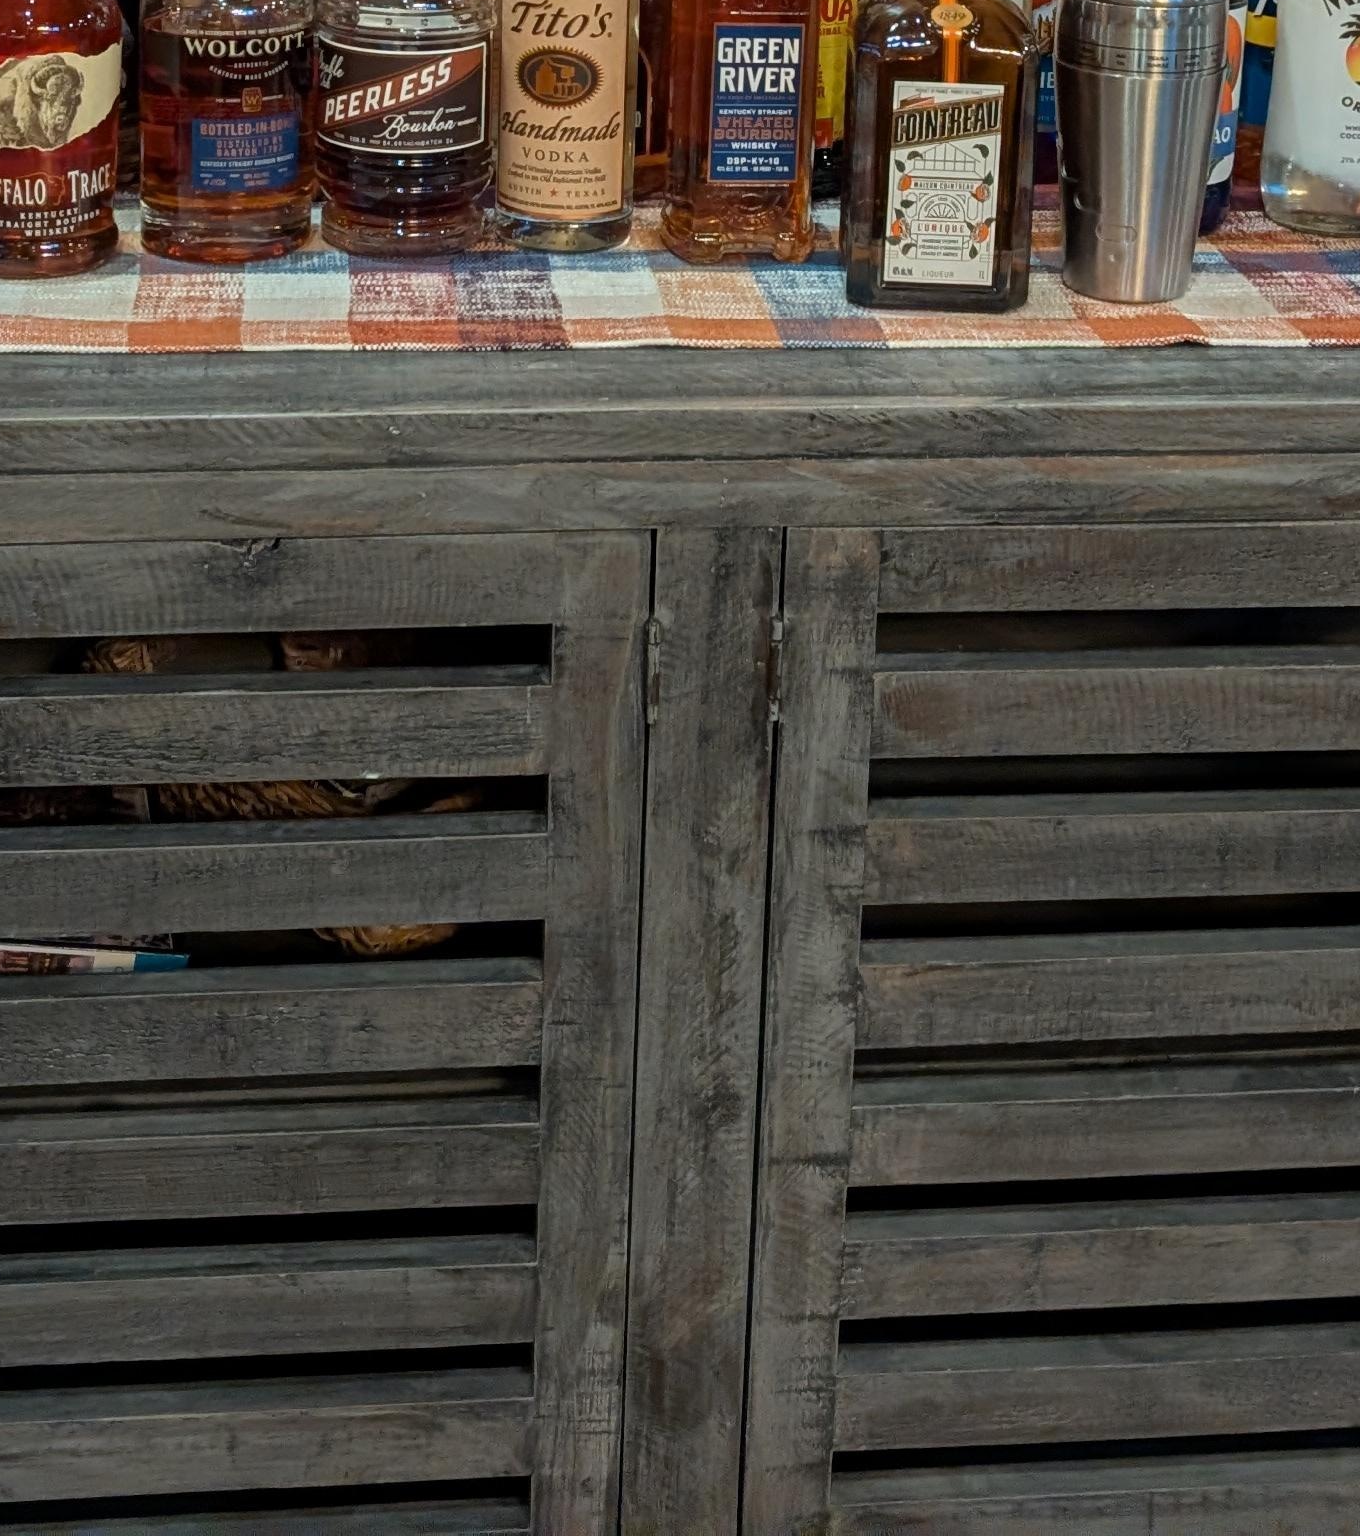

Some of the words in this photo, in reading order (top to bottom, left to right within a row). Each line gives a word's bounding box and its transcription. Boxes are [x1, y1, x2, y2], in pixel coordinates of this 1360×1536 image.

[510, 0, 613, 38] Tito's
[939, 11, 966, 20] 1849
[183, 31, 305, 58] WOLCOTT
[717, 37, 800, 64] GREEN
[719, 66, 796, 93] RIVER
[323, 56, 453, 124] PEERLESS
[373, 107, 457, 140] Bourbon
[501, 109, 621, 142] Handmade
[717, 116, 794, 128] WHEATED
[894, 99, 1002, 145] COINTREAU
[713, 128, 795, 140] BOURBON
[731, 141, 778, 150] WHISKEY
[522, 147, 589, 163] VODKA
[726, 157, 780, 165] DSP-KY-10
[68, 163, 111, 203] TRACE
[508, 183, 542, 196] AUSTIN
[566, 188, 606, 198] TEXAS
[20, 207, 79, 219] KENTUCKY
[56, 209, 101, 227] BOURBON
[25, 226, 75, 237] WHISKEY
[921, 270, 954, 278] LIQUEUR
